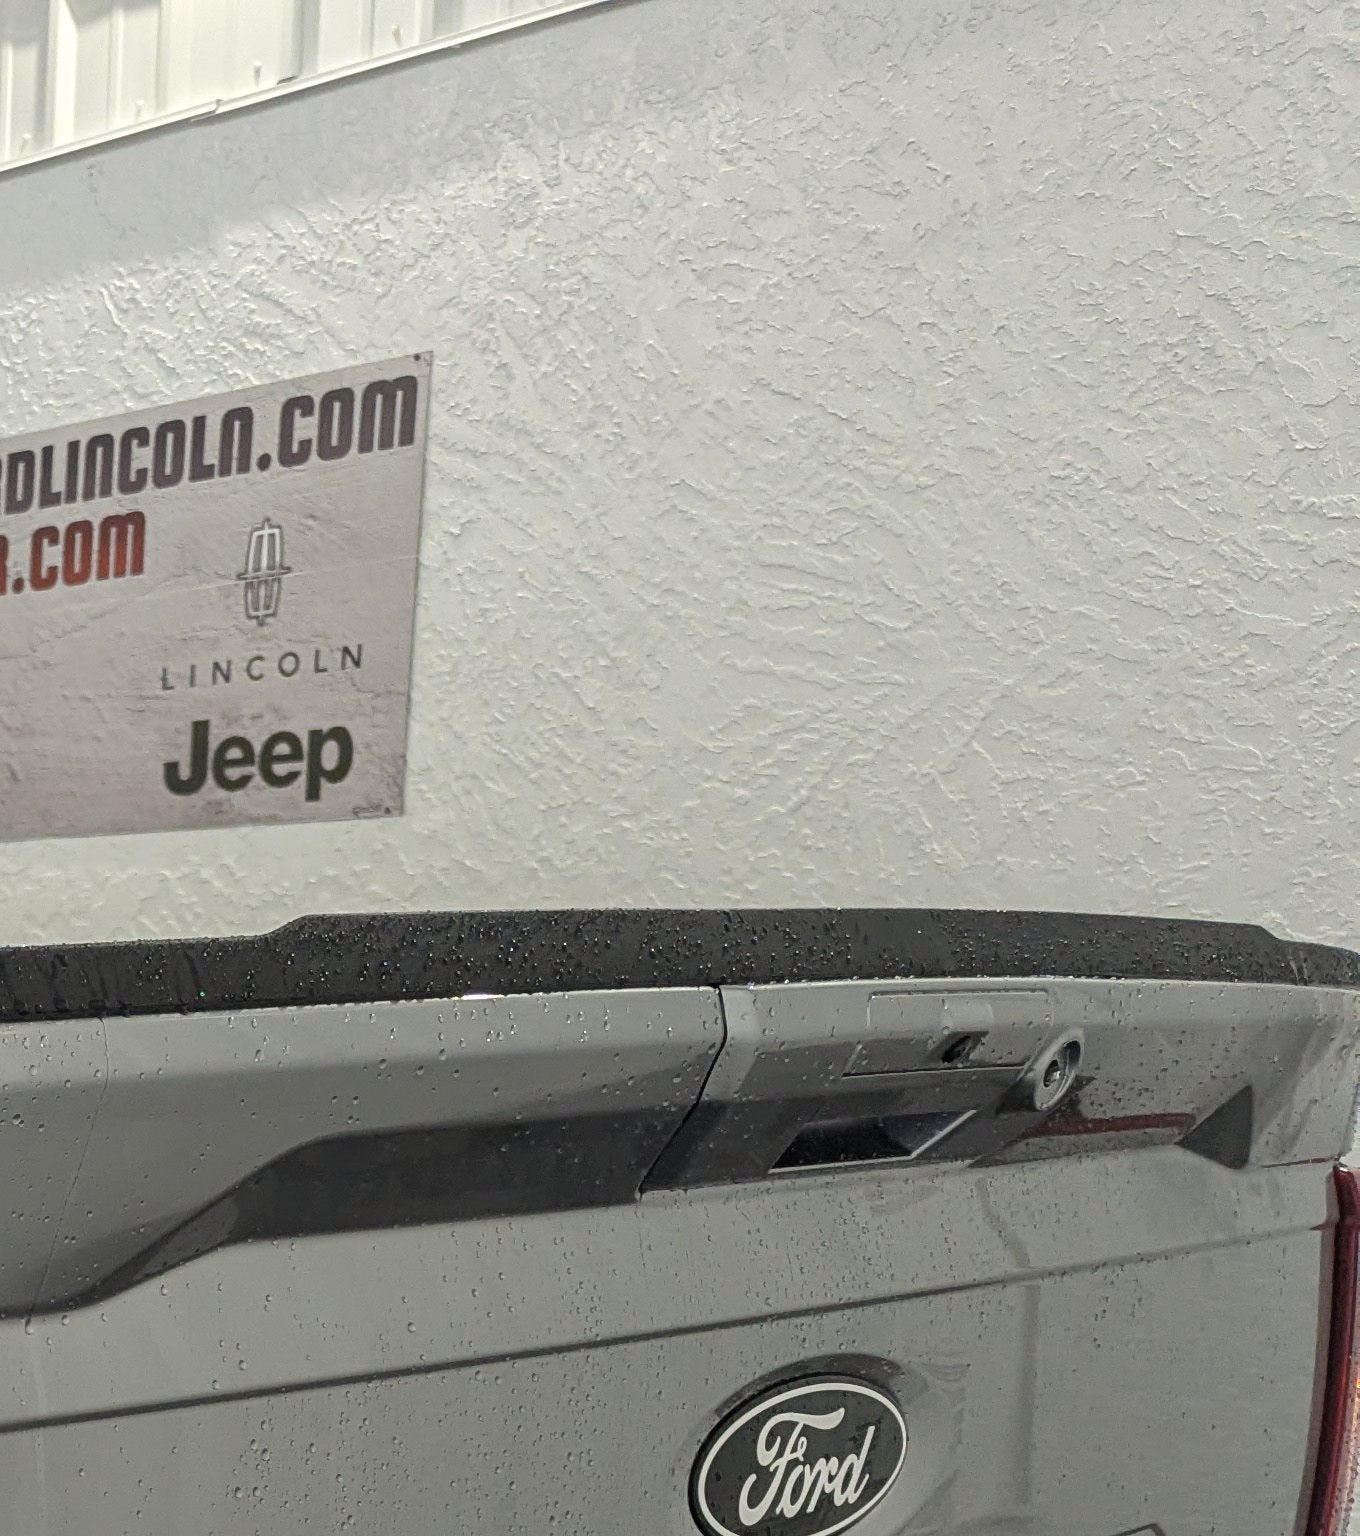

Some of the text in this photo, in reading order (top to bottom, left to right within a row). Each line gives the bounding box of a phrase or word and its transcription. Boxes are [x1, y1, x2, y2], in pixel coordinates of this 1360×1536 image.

[161, 643, 362, 691] LINCOLN
[163, 719, 354, 803] Jeep
[738, 1407, 876, 1526] Ford
